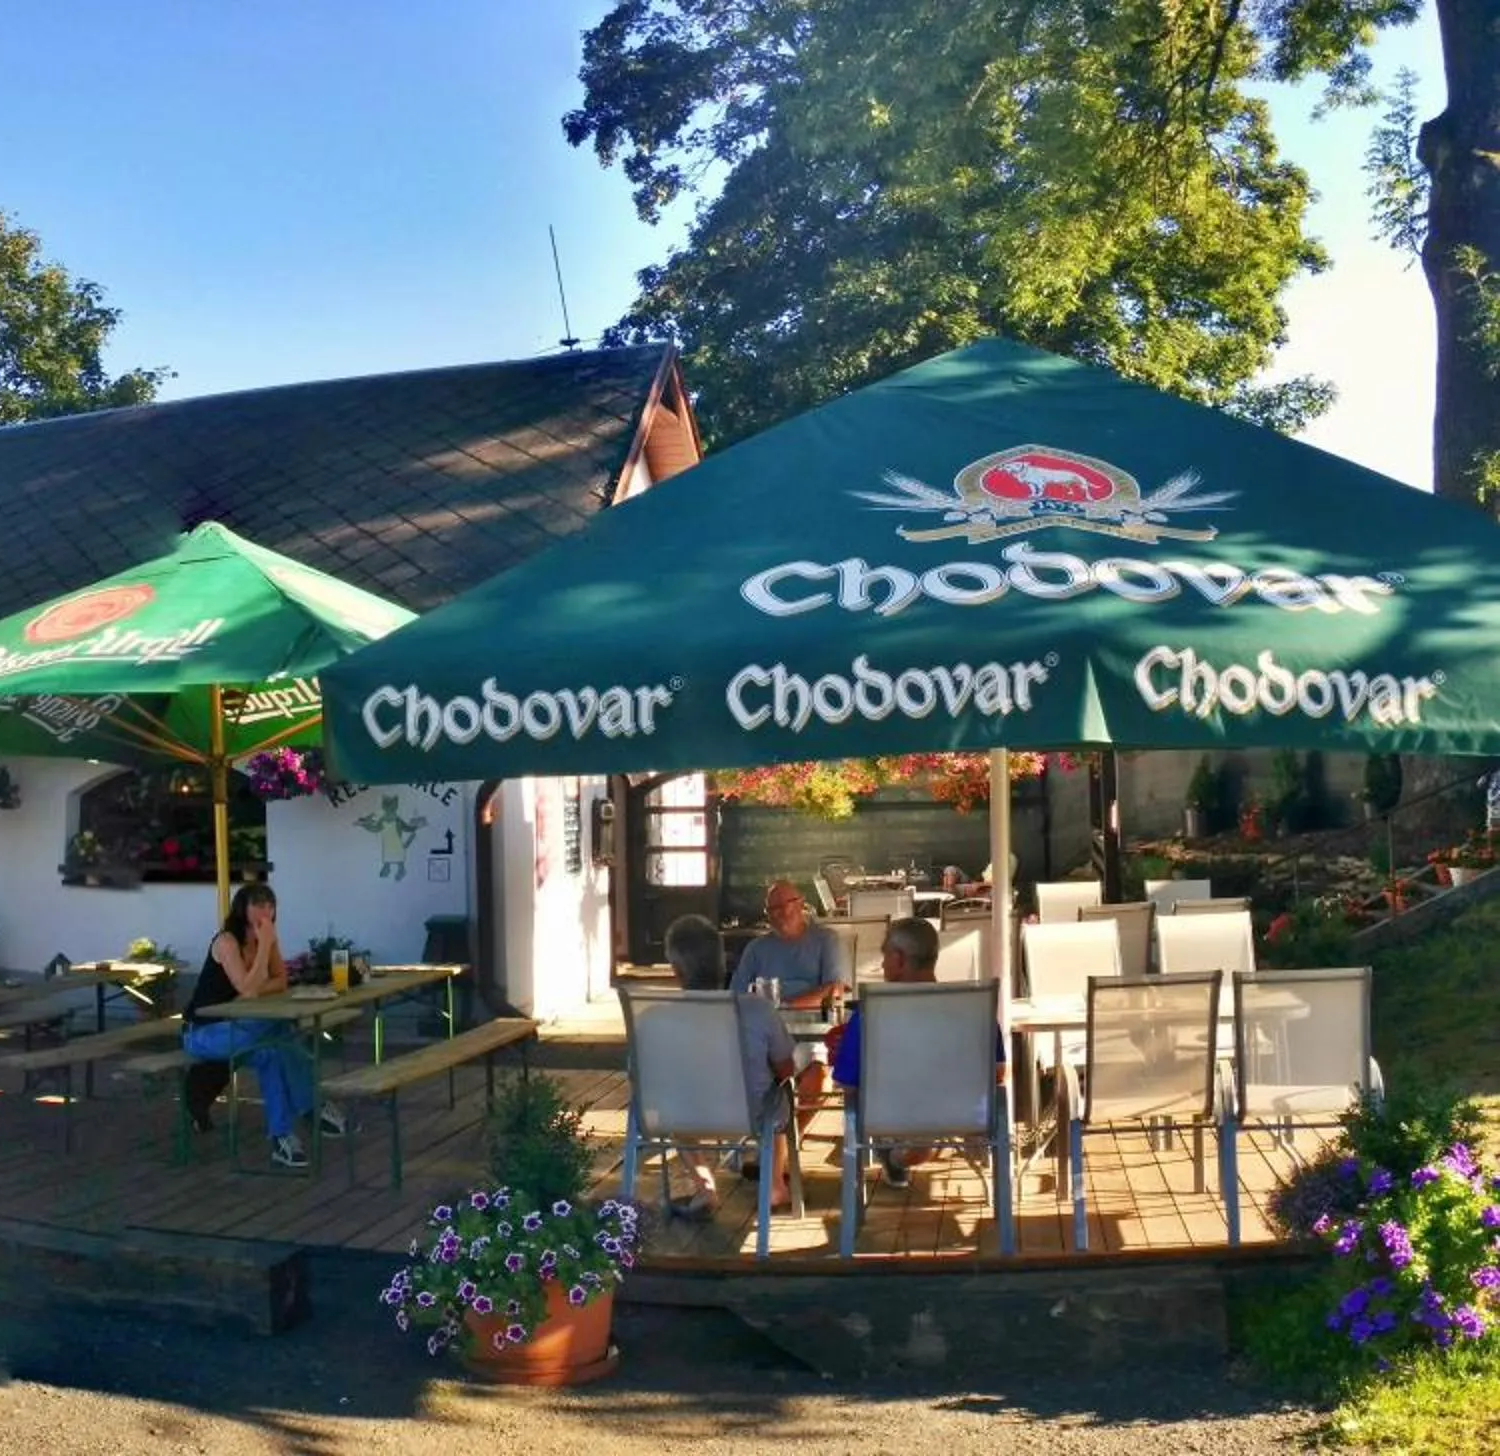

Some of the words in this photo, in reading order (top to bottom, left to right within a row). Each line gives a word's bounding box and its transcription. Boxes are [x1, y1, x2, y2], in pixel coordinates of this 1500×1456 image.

[740, 541, 1394, 617] Chodovar
[361, 676, 673, 752] Chodovar
[725, 653, 1048, 732] Chodovar
[1133, 645, 1440, 726] Chodovar
